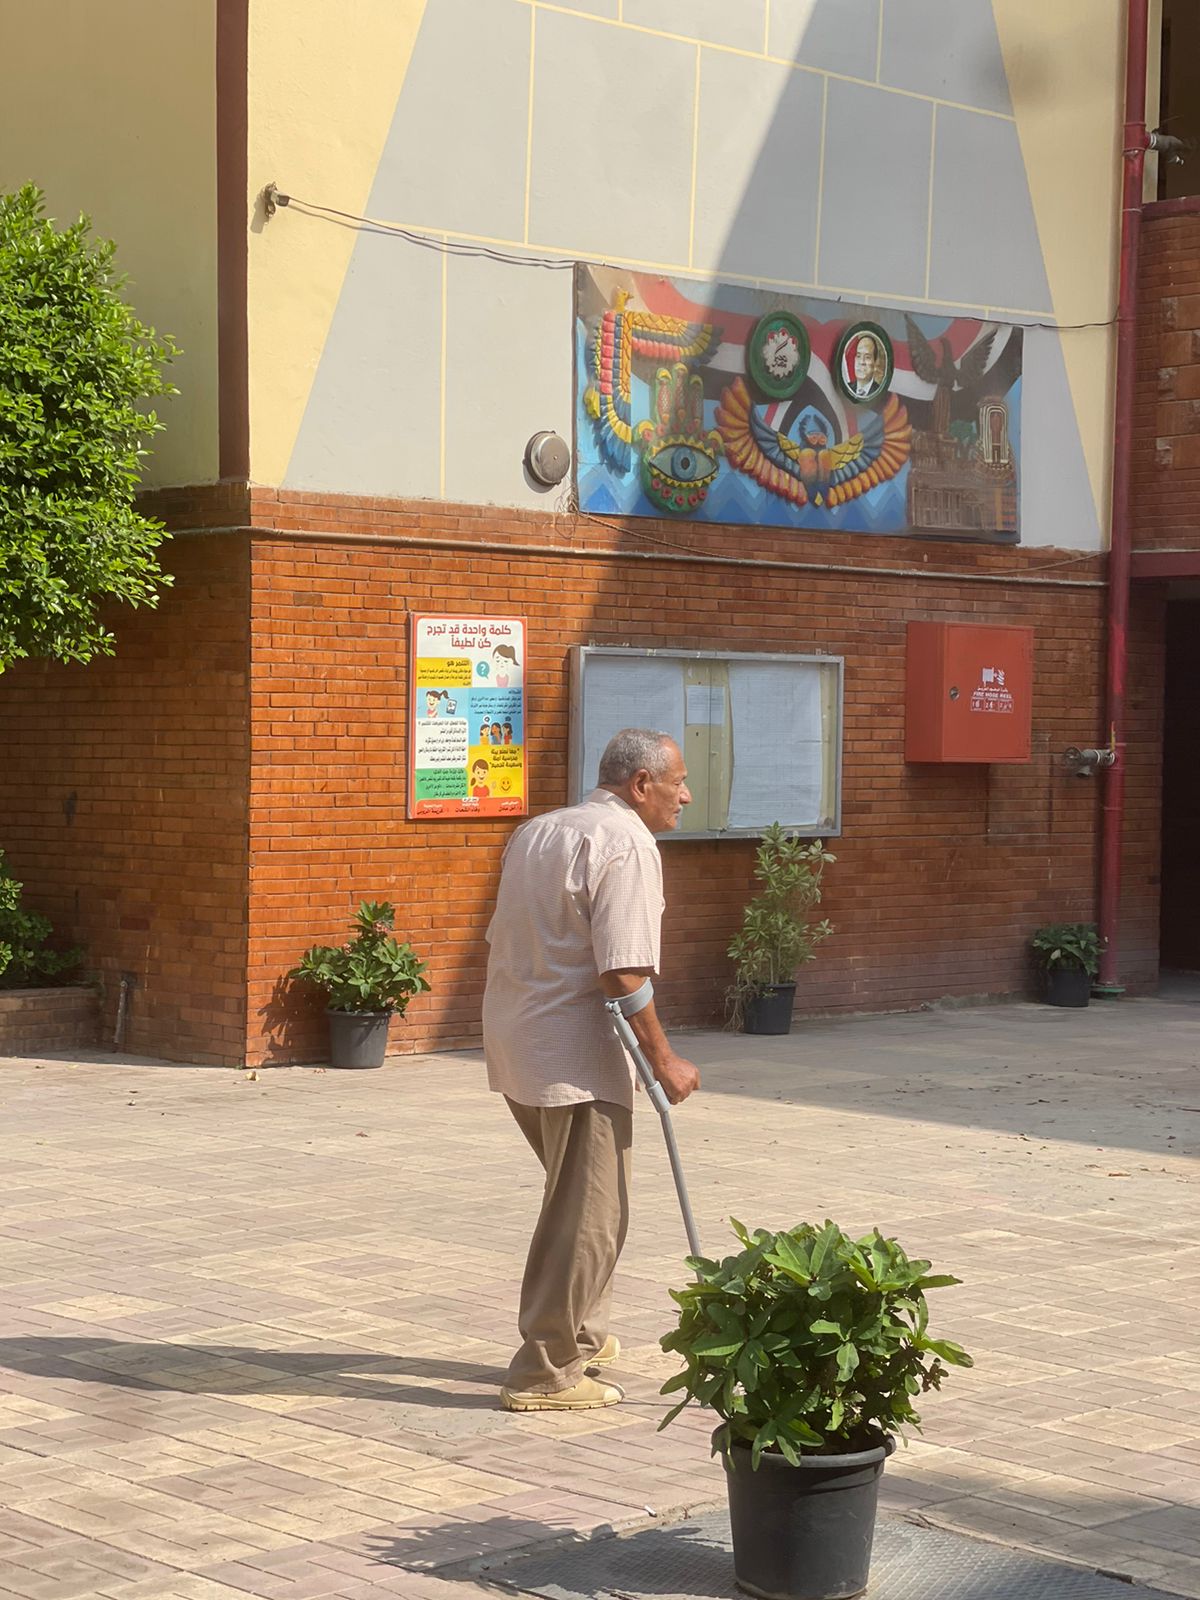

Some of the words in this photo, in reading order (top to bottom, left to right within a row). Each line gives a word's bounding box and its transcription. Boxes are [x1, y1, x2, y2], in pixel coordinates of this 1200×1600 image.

[427, 623, 446, 636] تجرح
[448, 623, 459, 634] قد
[462, 624, 486, 636] واحدة
[489, 624, 511, 635] كلمة
[451, 635, 475, 649] لطيفاً
[478, 637, 491, 649] كن
